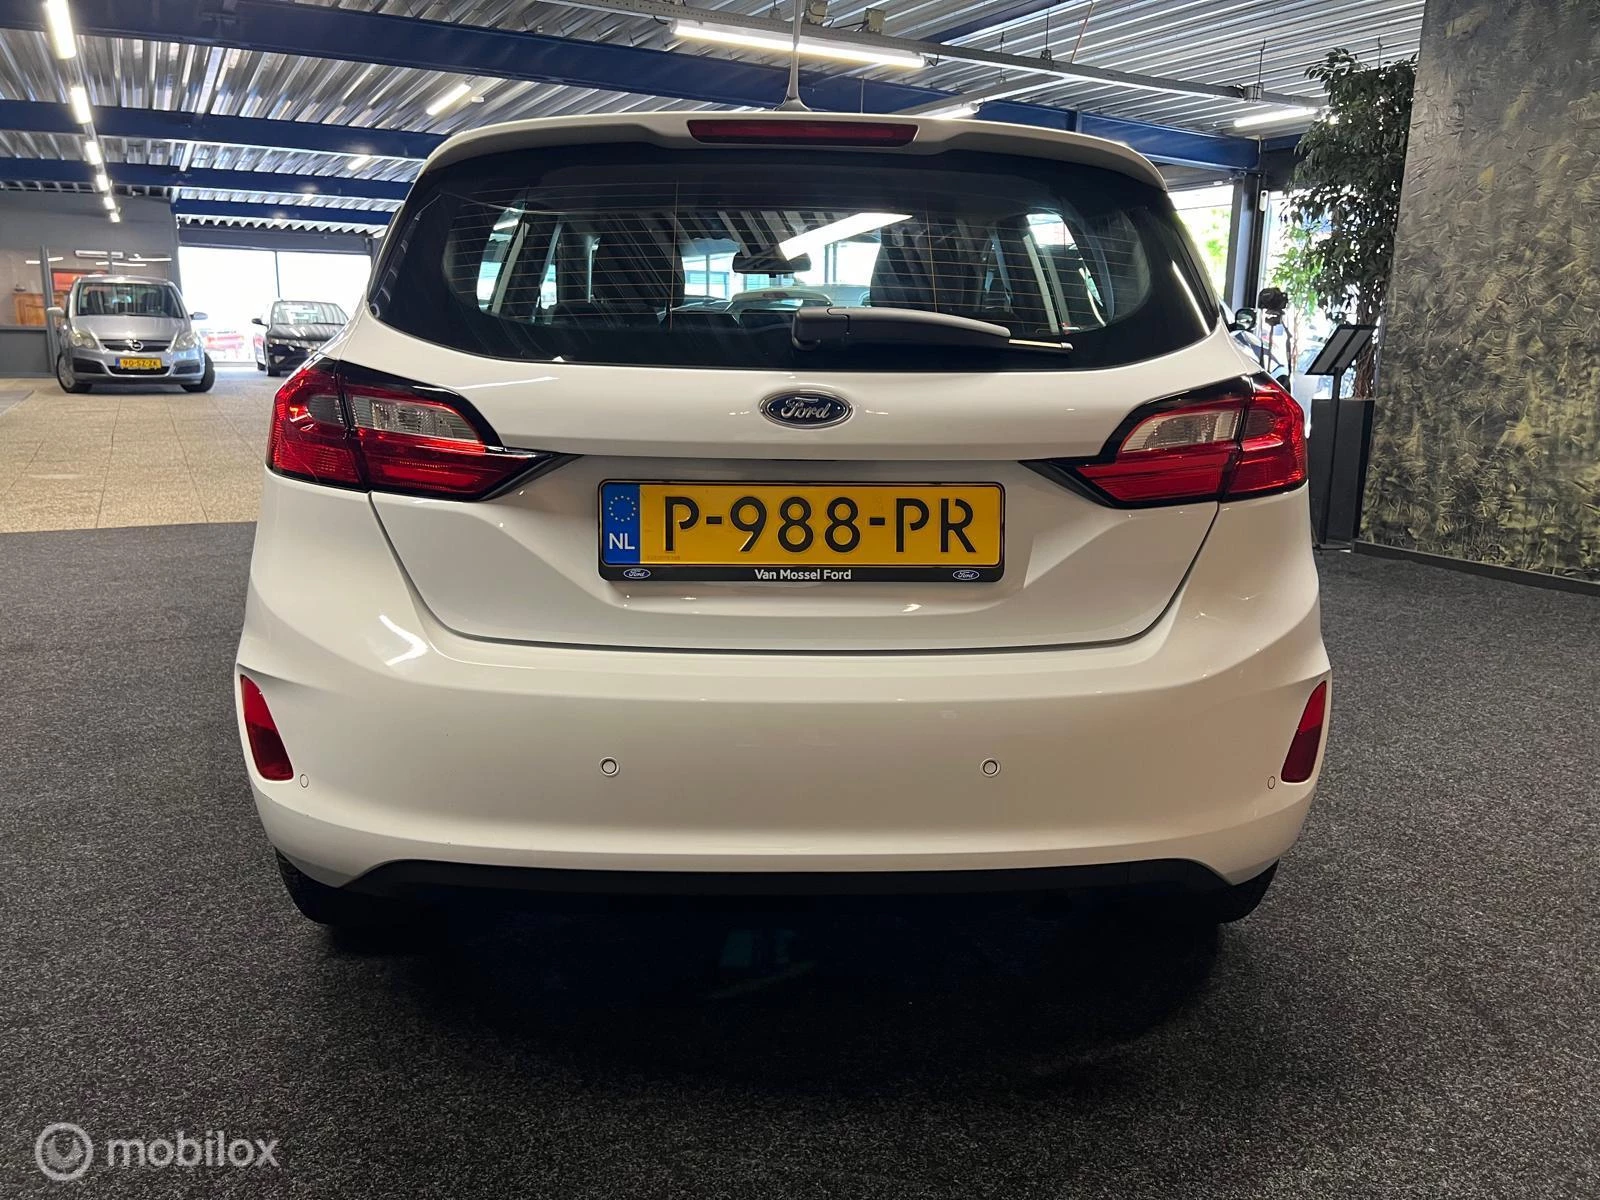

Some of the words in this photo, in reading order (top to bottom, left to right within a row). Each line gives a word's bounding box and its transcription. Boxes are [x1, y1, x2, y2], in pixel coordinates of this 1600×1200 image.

[780, 396, 831, 418] Ford
[664, 496, 977, 553] P-988-PR
[608, 532, 636, 550] NL
[754, 568, 777, 580] Van
[780, 568, 820, 580] Mossel
[823, 568, 852, 580] Ford
